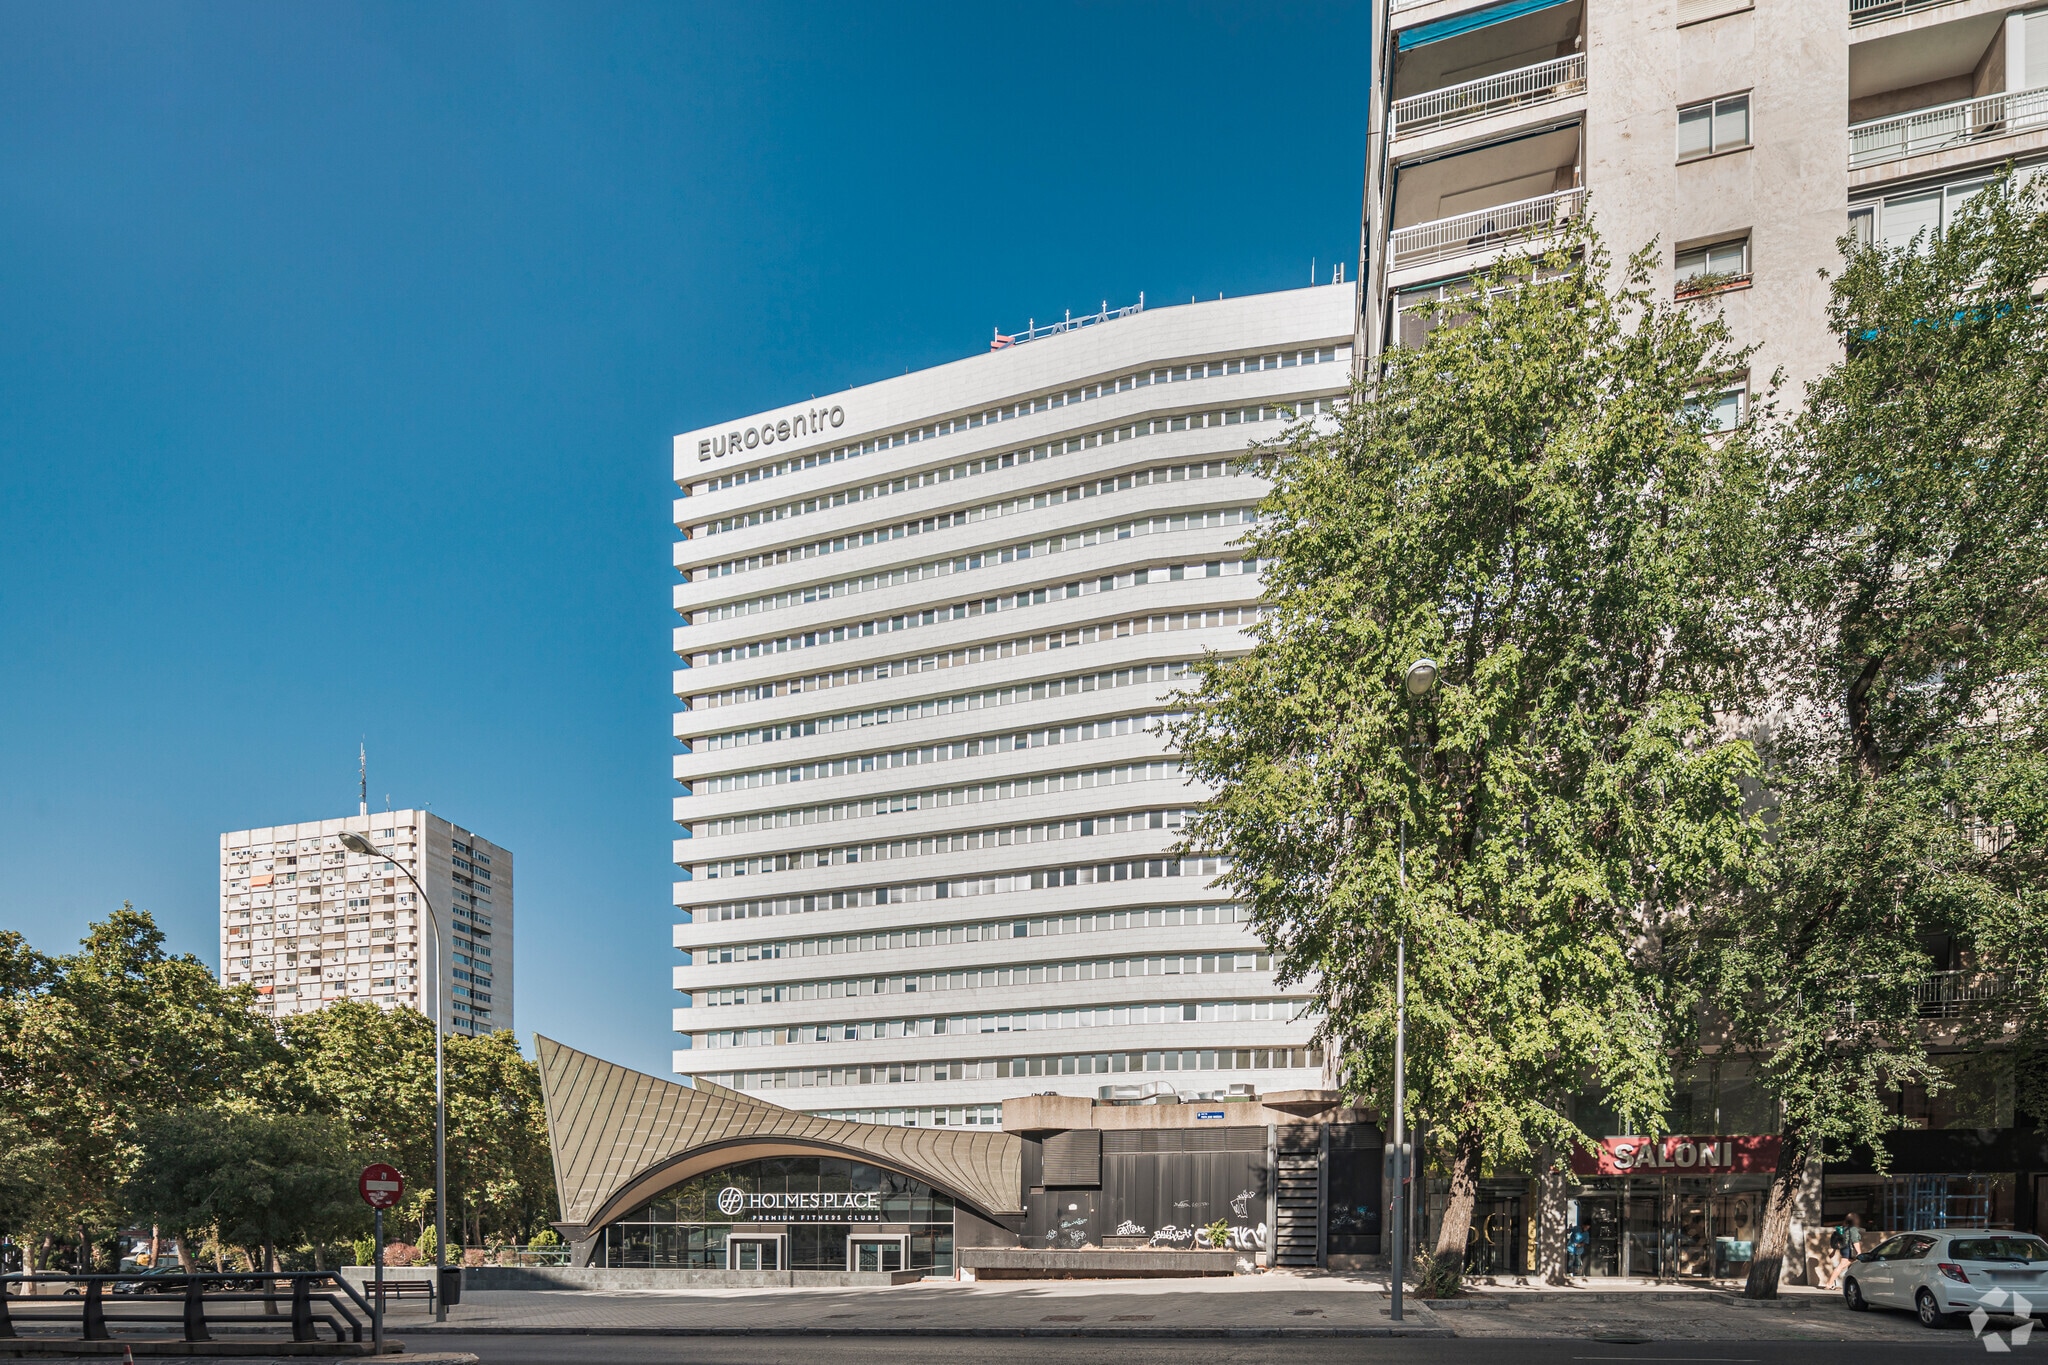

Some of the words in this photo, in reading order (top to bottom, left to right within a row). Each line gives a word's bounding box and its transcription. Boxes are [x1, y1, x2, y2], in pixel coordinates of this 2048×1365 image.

[698, 405, 845, 462] EUROcentro
[1613, 1142, 1732, 1169] SALONI
[750, 1193, 819, 1208] HOLMES
[824, 1193, 878, 1208] PLACE
